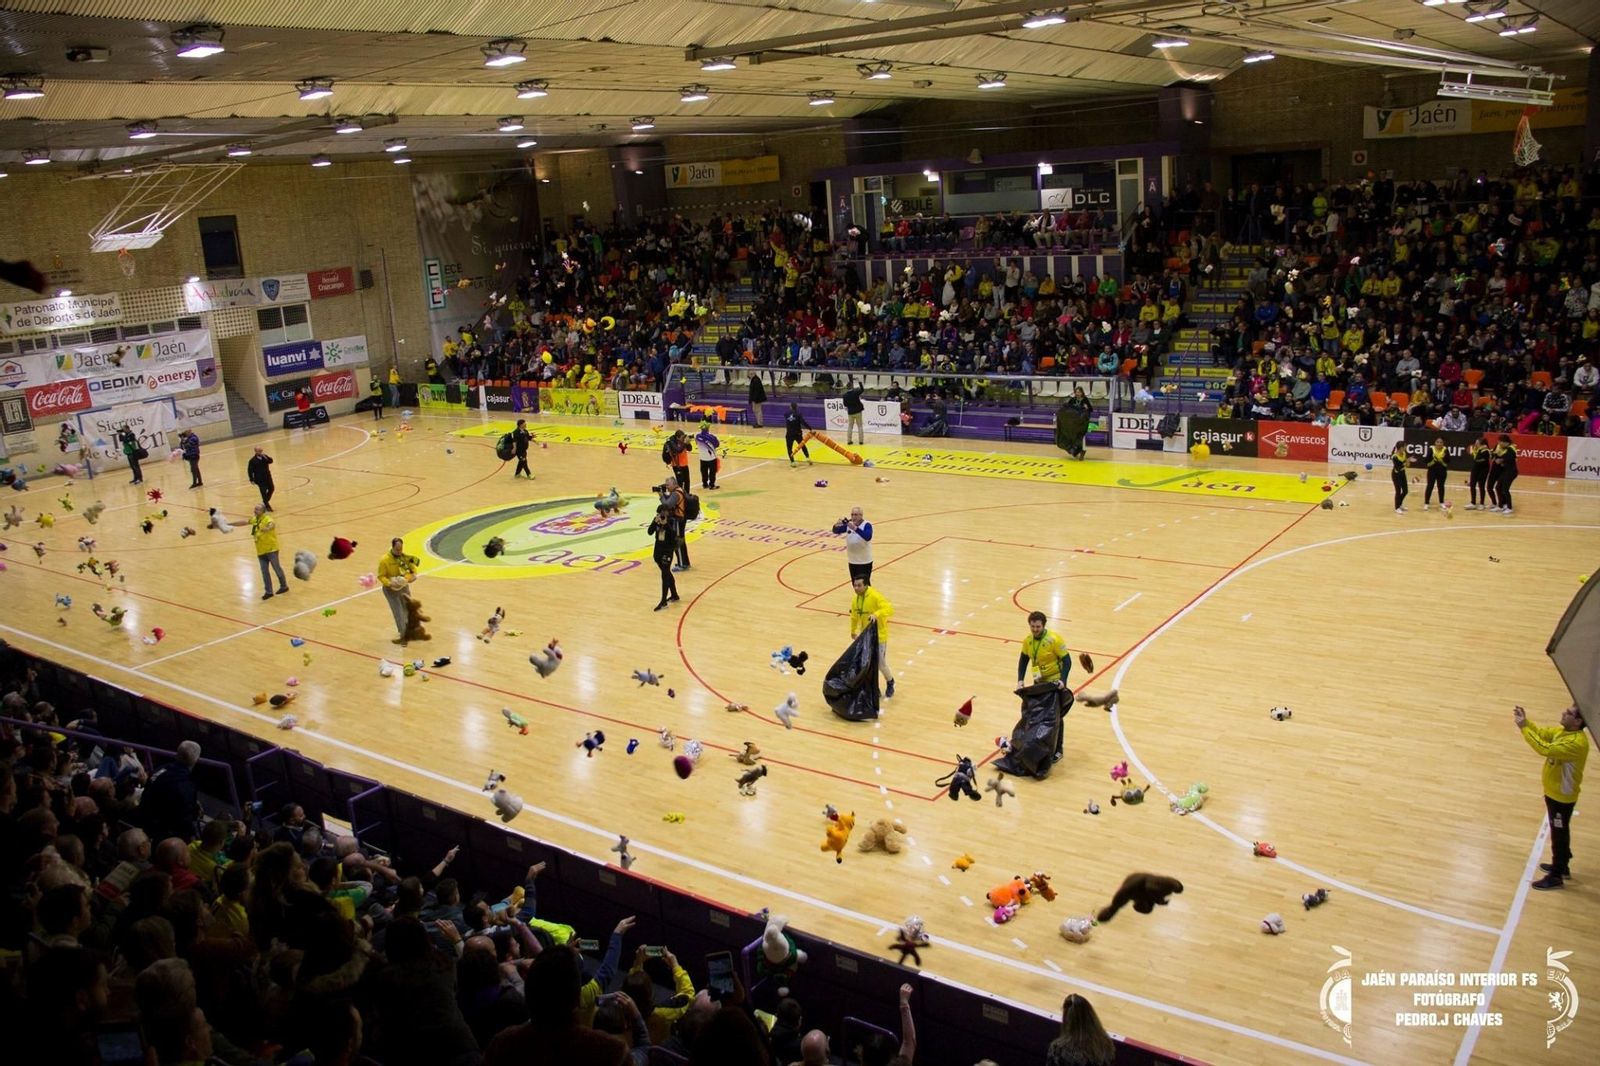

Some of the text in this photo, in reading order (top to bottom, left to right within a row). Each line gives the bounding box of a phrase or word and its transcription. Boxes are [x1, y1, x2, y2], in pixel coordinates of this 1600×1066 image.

[1409, 103, 1456, 127] Jaén
[689, 165, 714, 180] Jaén
[1074, 192, 1110, 205] DLC
[444, 263, 463, 275] ECE
[14, 302, 66, 316] Patronato
[17, 307, 121, 328] de Deportes de Jaén
[152, 339, 187, 357] Jaén
[267, 349, 307, 367] luanvi
[157, 367, 198, 383] energy
[88, 374, 145, 392] OEDIM
[486, 394, 511, 405] cajasur
[622, 393, 660, 406] IDEAL
[571, 403, 584, 415] 27
[1193, 429, 1243, 444] cajasur
[1275, 434, 1326, 446] ESCAYESCOS
[1331, 447, 1393, 462] Campoamen
[1406, 441, 1466, 457] cajur
[1515, 449, 1564, 459] CAYESCOS
[748, 533, 780, 544] de
